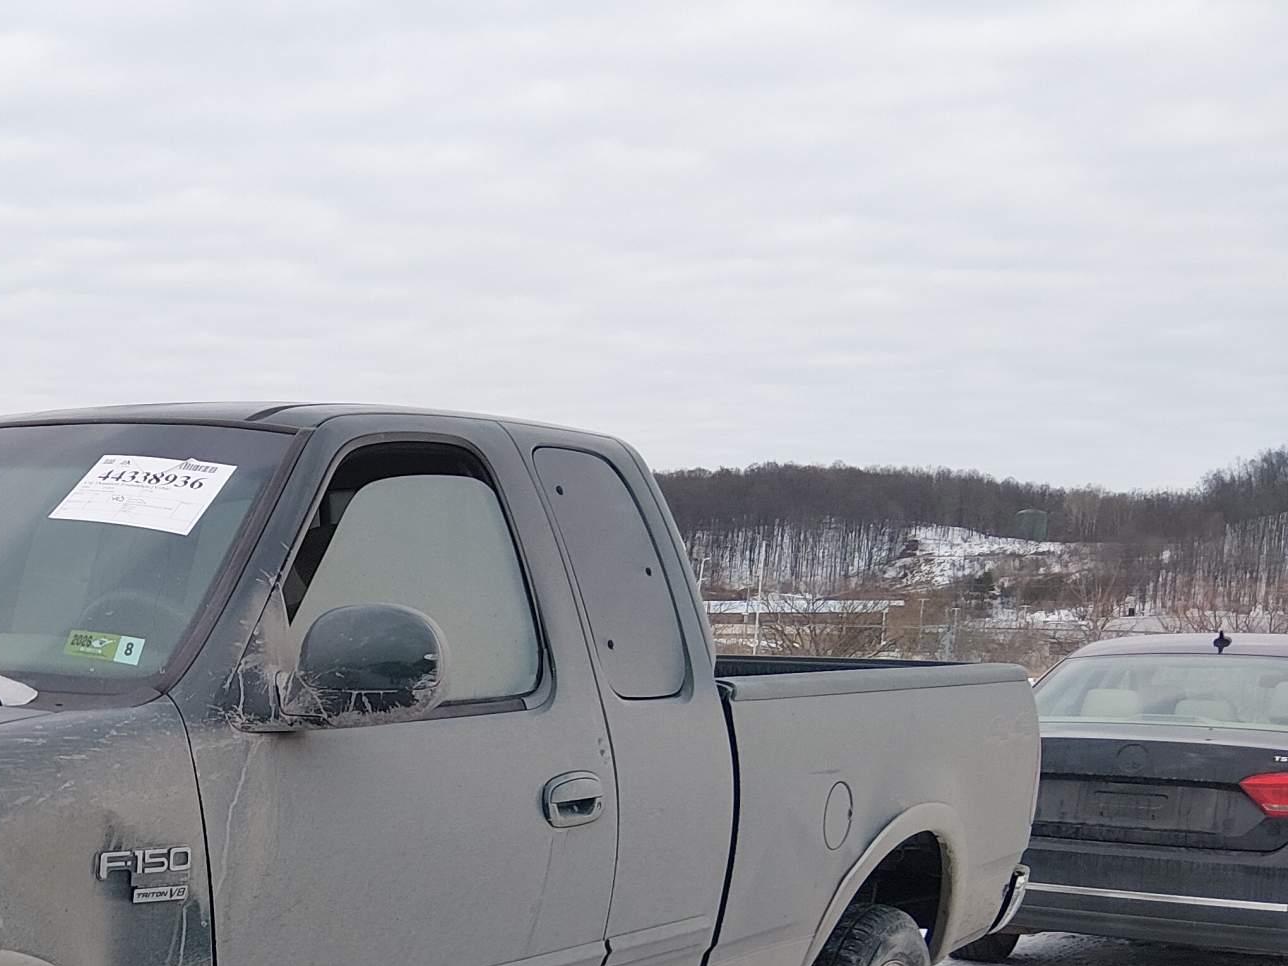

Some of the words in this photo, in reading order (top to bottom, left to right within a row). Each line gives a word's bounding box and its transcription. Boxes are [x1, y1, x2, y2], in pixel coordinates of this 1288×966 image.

[98, 469, 208, 489] 44338936
[124, 642, 134, 656] 8
[136, 891, 168, 899] TRITON
[169, 887, 186, 899] V8
